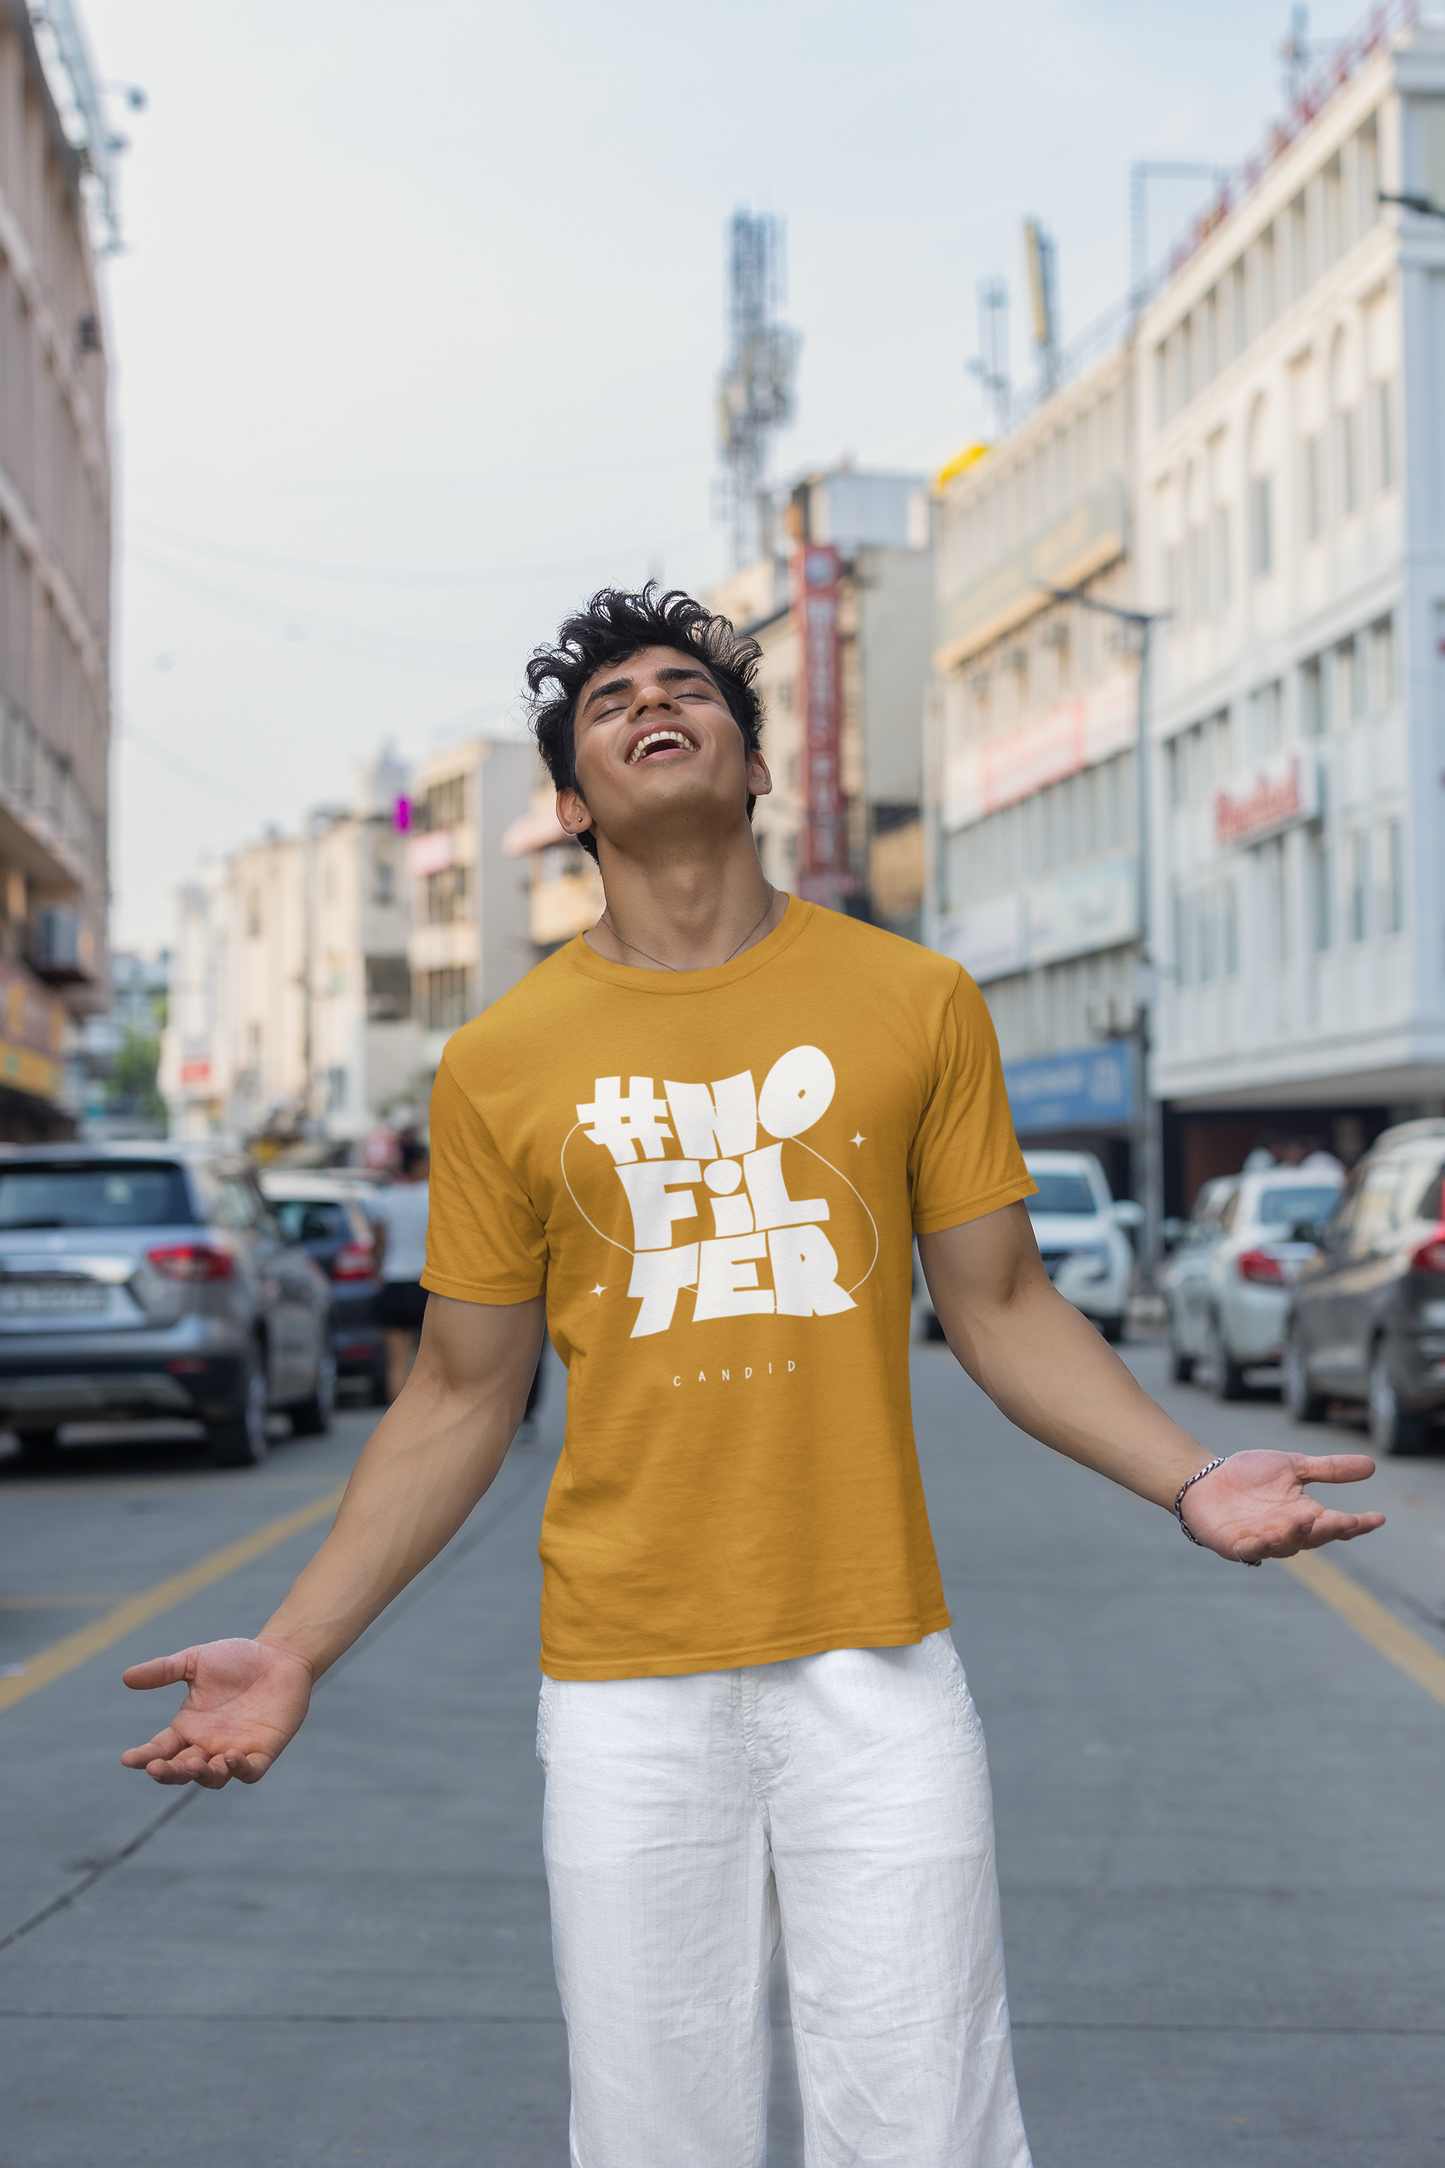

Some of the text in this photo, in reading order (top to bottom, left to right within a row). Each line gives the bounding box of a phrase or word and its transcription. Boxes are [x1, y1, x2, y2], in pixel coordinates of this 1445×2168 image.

[575, 1045, 836, 1165] #NO
[627, 1224, 859, 1339] TER
[673, 1359, 796, 1387] CANDID
